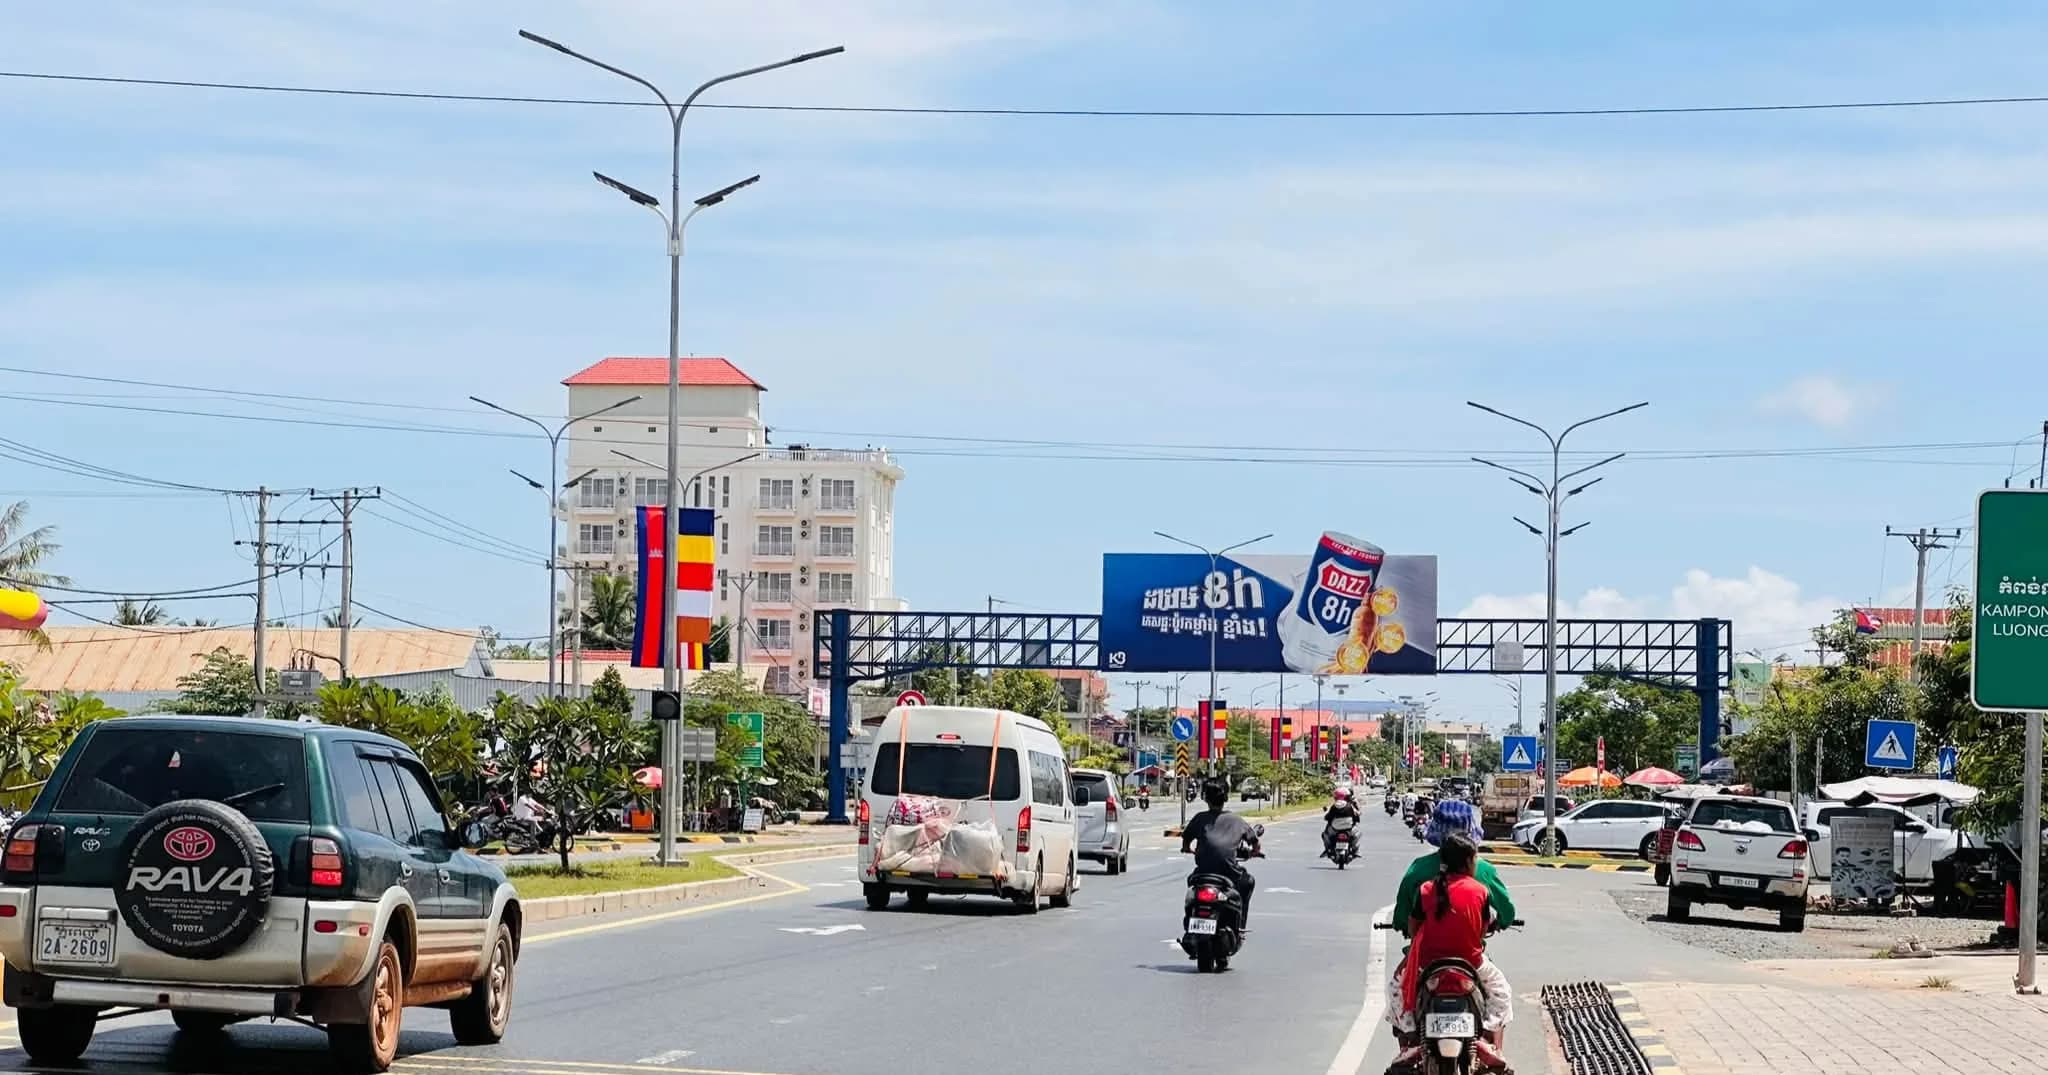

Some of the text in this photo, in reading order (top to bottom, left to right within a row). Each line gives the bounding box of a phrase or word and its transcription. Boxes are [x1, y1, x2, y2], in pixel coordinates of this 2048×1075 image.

[1327, 571, 1367, 595] DAZZ
[1321, 596, 1352, 625] 8h
[1993, 623, 2048, 637] LUONG
[126, 866, 254, 896] RAV4
[172, 923, 205, 933] TOYOTA
